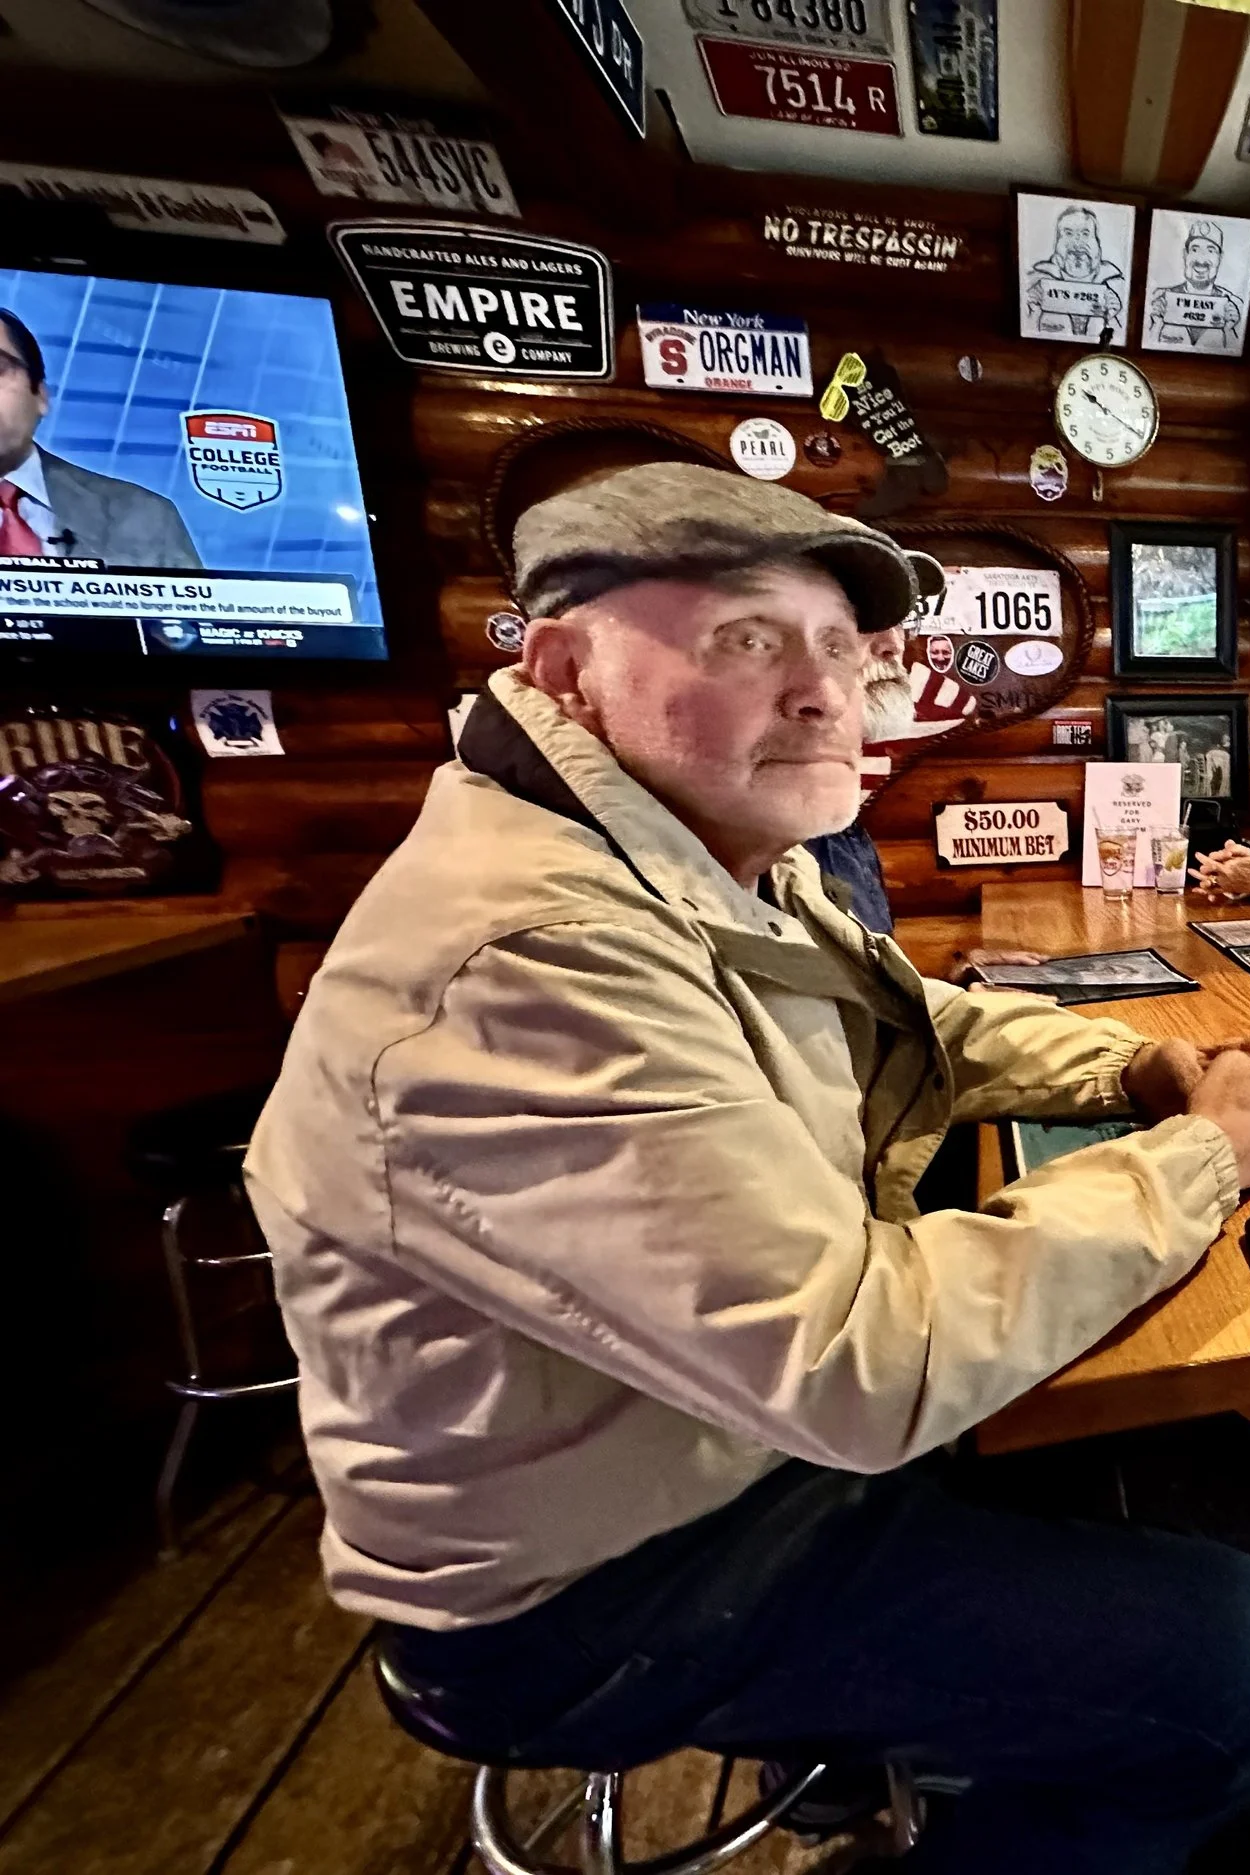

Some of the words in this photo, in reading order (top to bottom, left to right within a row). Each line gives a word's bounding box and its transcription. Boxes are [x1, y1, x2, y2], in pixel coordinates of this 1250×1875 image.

[754, 64, 857, 115] 7514
[867, 86, 886, 113] R
[363, 130, 503, 201] 544SVC
[854, 212, 880, 225] WILL
[764, 215, 799, 243] NO
[361, 243, 462, 265] HANDCRAFTED
[465, 255, 498, 269] ALES
[500, 257, 528, 271] AND
[532, 260, 583, 276] LAGERS
[786, 245, 841, 262] SURVIVORS
[844, 251, 867, 264] WILL
[870, 254, 883, 266] BE
[886, 256, 911, 269] SHOT
[389, 280, 584, 331] EMPIRE
[683, 308, 723, 325] New
[725, 312, 765, 329] York
[428, 341, 481, 357] BREWING
[521, 347, 572, 364] COMPANY
[659, 339, 688, 375] S
[700, 330, 802, 378] ORGMAN
[1081, 368, 1089, 382] 5
[1100, 363, 1108, 376] 5
[1119, 370, 1127, 383] 5
[704, 377, 753, 390] ORANGE
[1068, 383, 1076, 396] 5
[1134, 386, 1142, 398] 5
[1063, 404, 1072, 417] 5
[1142, 407, 1150, 418] 5
[204, 421, 257, 437] ESPN
[1070, 425, 1078, 437] 5
[740, 440, 785, 456] PEARL
[887, 433, 923, 459] Boot
[1084, 441, 1092, 454] 5
[1106, 448, 1114, 460] 5
[1125, 442, 1132, 454] 5
[190, 448, 279, 466] COLLEGE
[201, 464, 273, 475] FOOTBALL
[64, 559, 99, 569] LIVE
[71, 582, 166, 597] AGAINST
[172, 585, 213, 598] LSU
[53, 598, 88, 608] school
[91, 600, 123, 609] would
[125, 602, 139, 610] no
[141, 602, 174, 613] longer
[200, 603, 216, 612] the
[218, 604, 236, 613] full
[237, 606, 275, 615] amount
[277, 605, 287, 615] of
[289, 606, 306, 616] the
[307, 607, 342, 618] buyout
[975, 591, 1052, 631] 1065
[200, 628, 241, 639] MAGIC
[257, 629, 304, 641] KNICKS
[967, 645, 995, 668] GREAT
[961, 657, 990, 680] LAKES
[964, 808, 1040, 833] $50.00
[952, 835, 1021, 859] MINIMUM
[1024, 834, 1056, 856] BET
